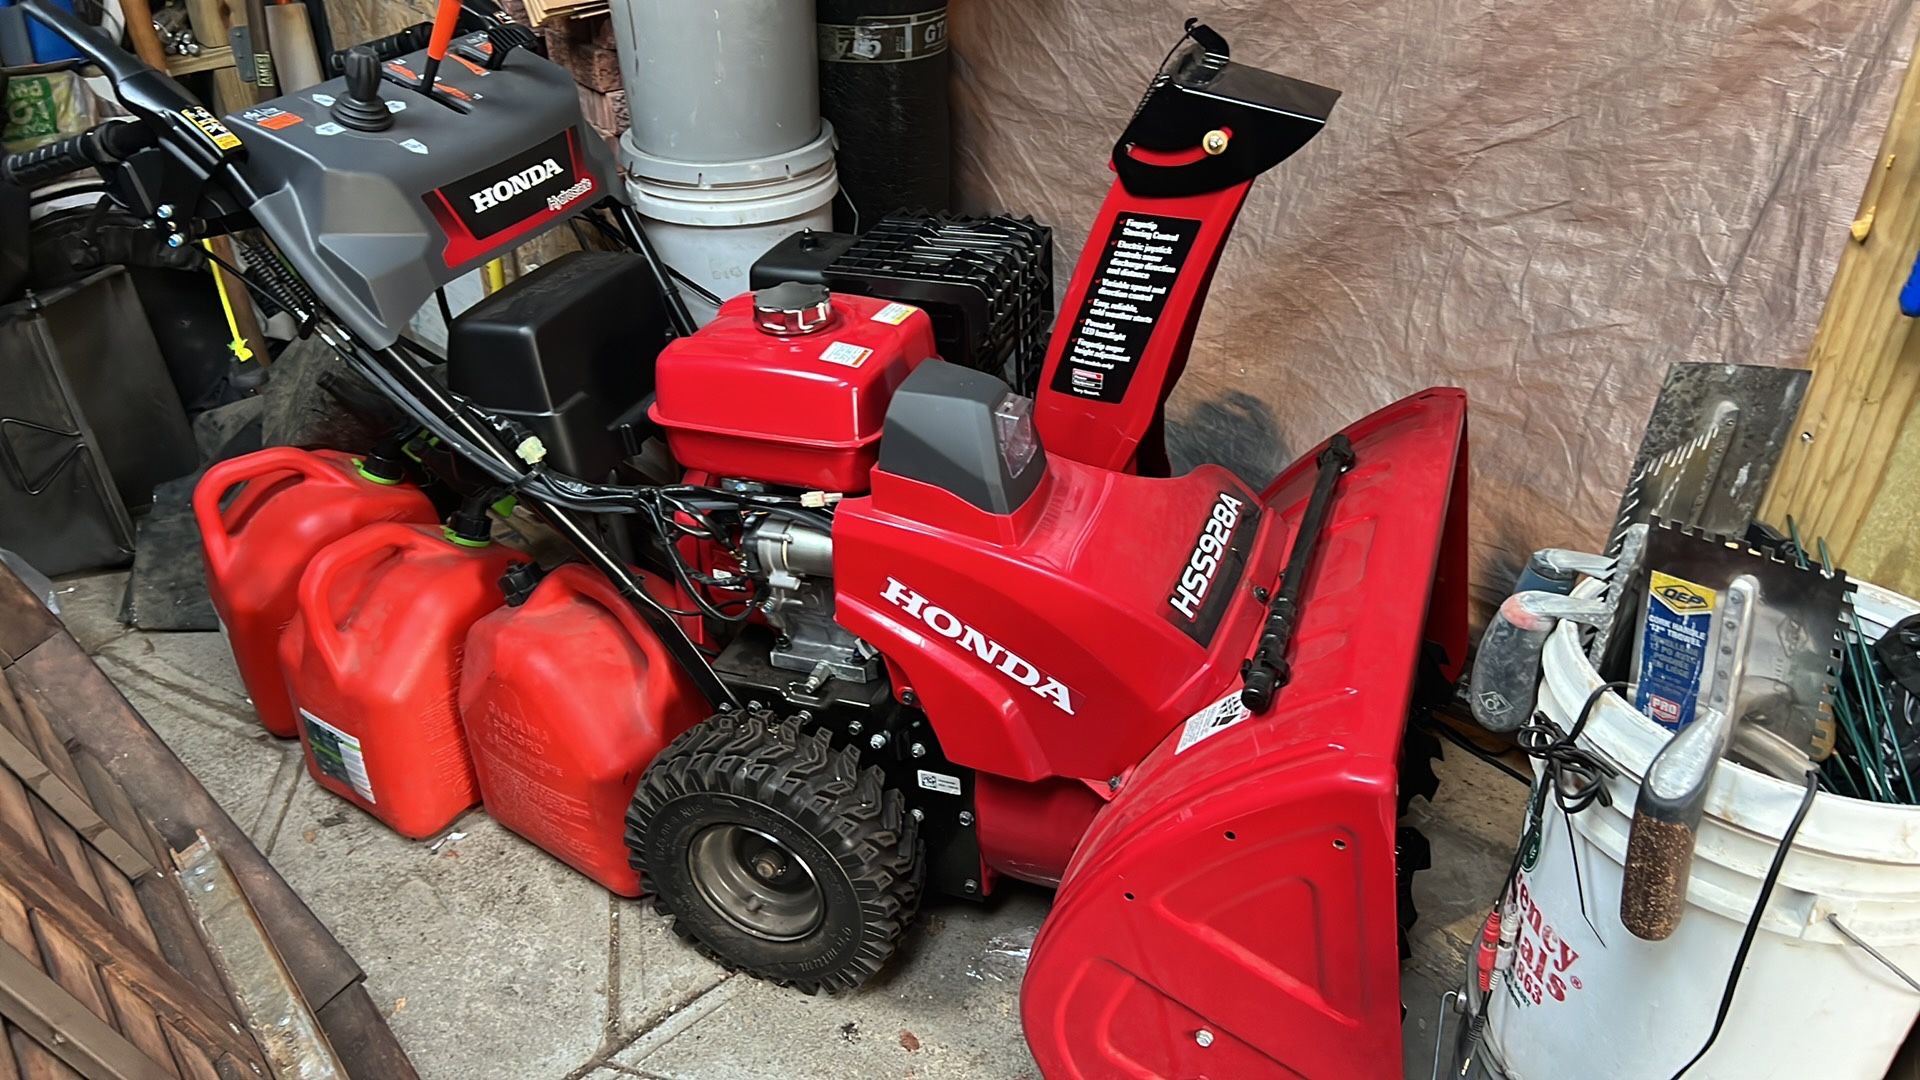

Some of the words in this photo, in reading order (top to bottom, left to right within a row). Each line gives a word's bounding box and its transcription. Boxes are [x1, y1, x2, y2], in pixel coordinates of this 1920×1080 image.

[469, 158, 564, 213] HONDA
[1122, 227, 1153, 240] Steering
[1153, 231, 1180, 242] Control
[1113, 250, 1142, 261] controls
[1117, 240, 1145, 251] Electric
[1144, 243, 1173, 255] joystick
[1106, 267, 1121, 276] and
[1120, 268, 1151, 280] distance
[1109, 258, 1145, 270] discharge
[1144, 262, 1177, 274] direction
[1098, 286, 1129, 299] direction
[1128, 293, 1154, 302] control
[1102, 278, 1131, 290] Variable
[1130, 284, 1153, 293] speed
[1152, 286, 1167, 295] and
[1089, 308, 1106, 317] cold
[1104, 311, 1134, 321] weather
[1132, 315, 1154, 324] starts
[1081, 326, 1096, 336] LED
[1095, 329, 1127, 342] headlight
[1170, 492, 1243, 619] HSS928A
[1648, 614, 1671, 629] CORK
[1672, 622, 1707, 641] HANDLE
[879, 576, 1076, 716] HONDA
[1667, 629, 1702, 647] TROWEL
[1651, 695, 1678, 714] PRO
